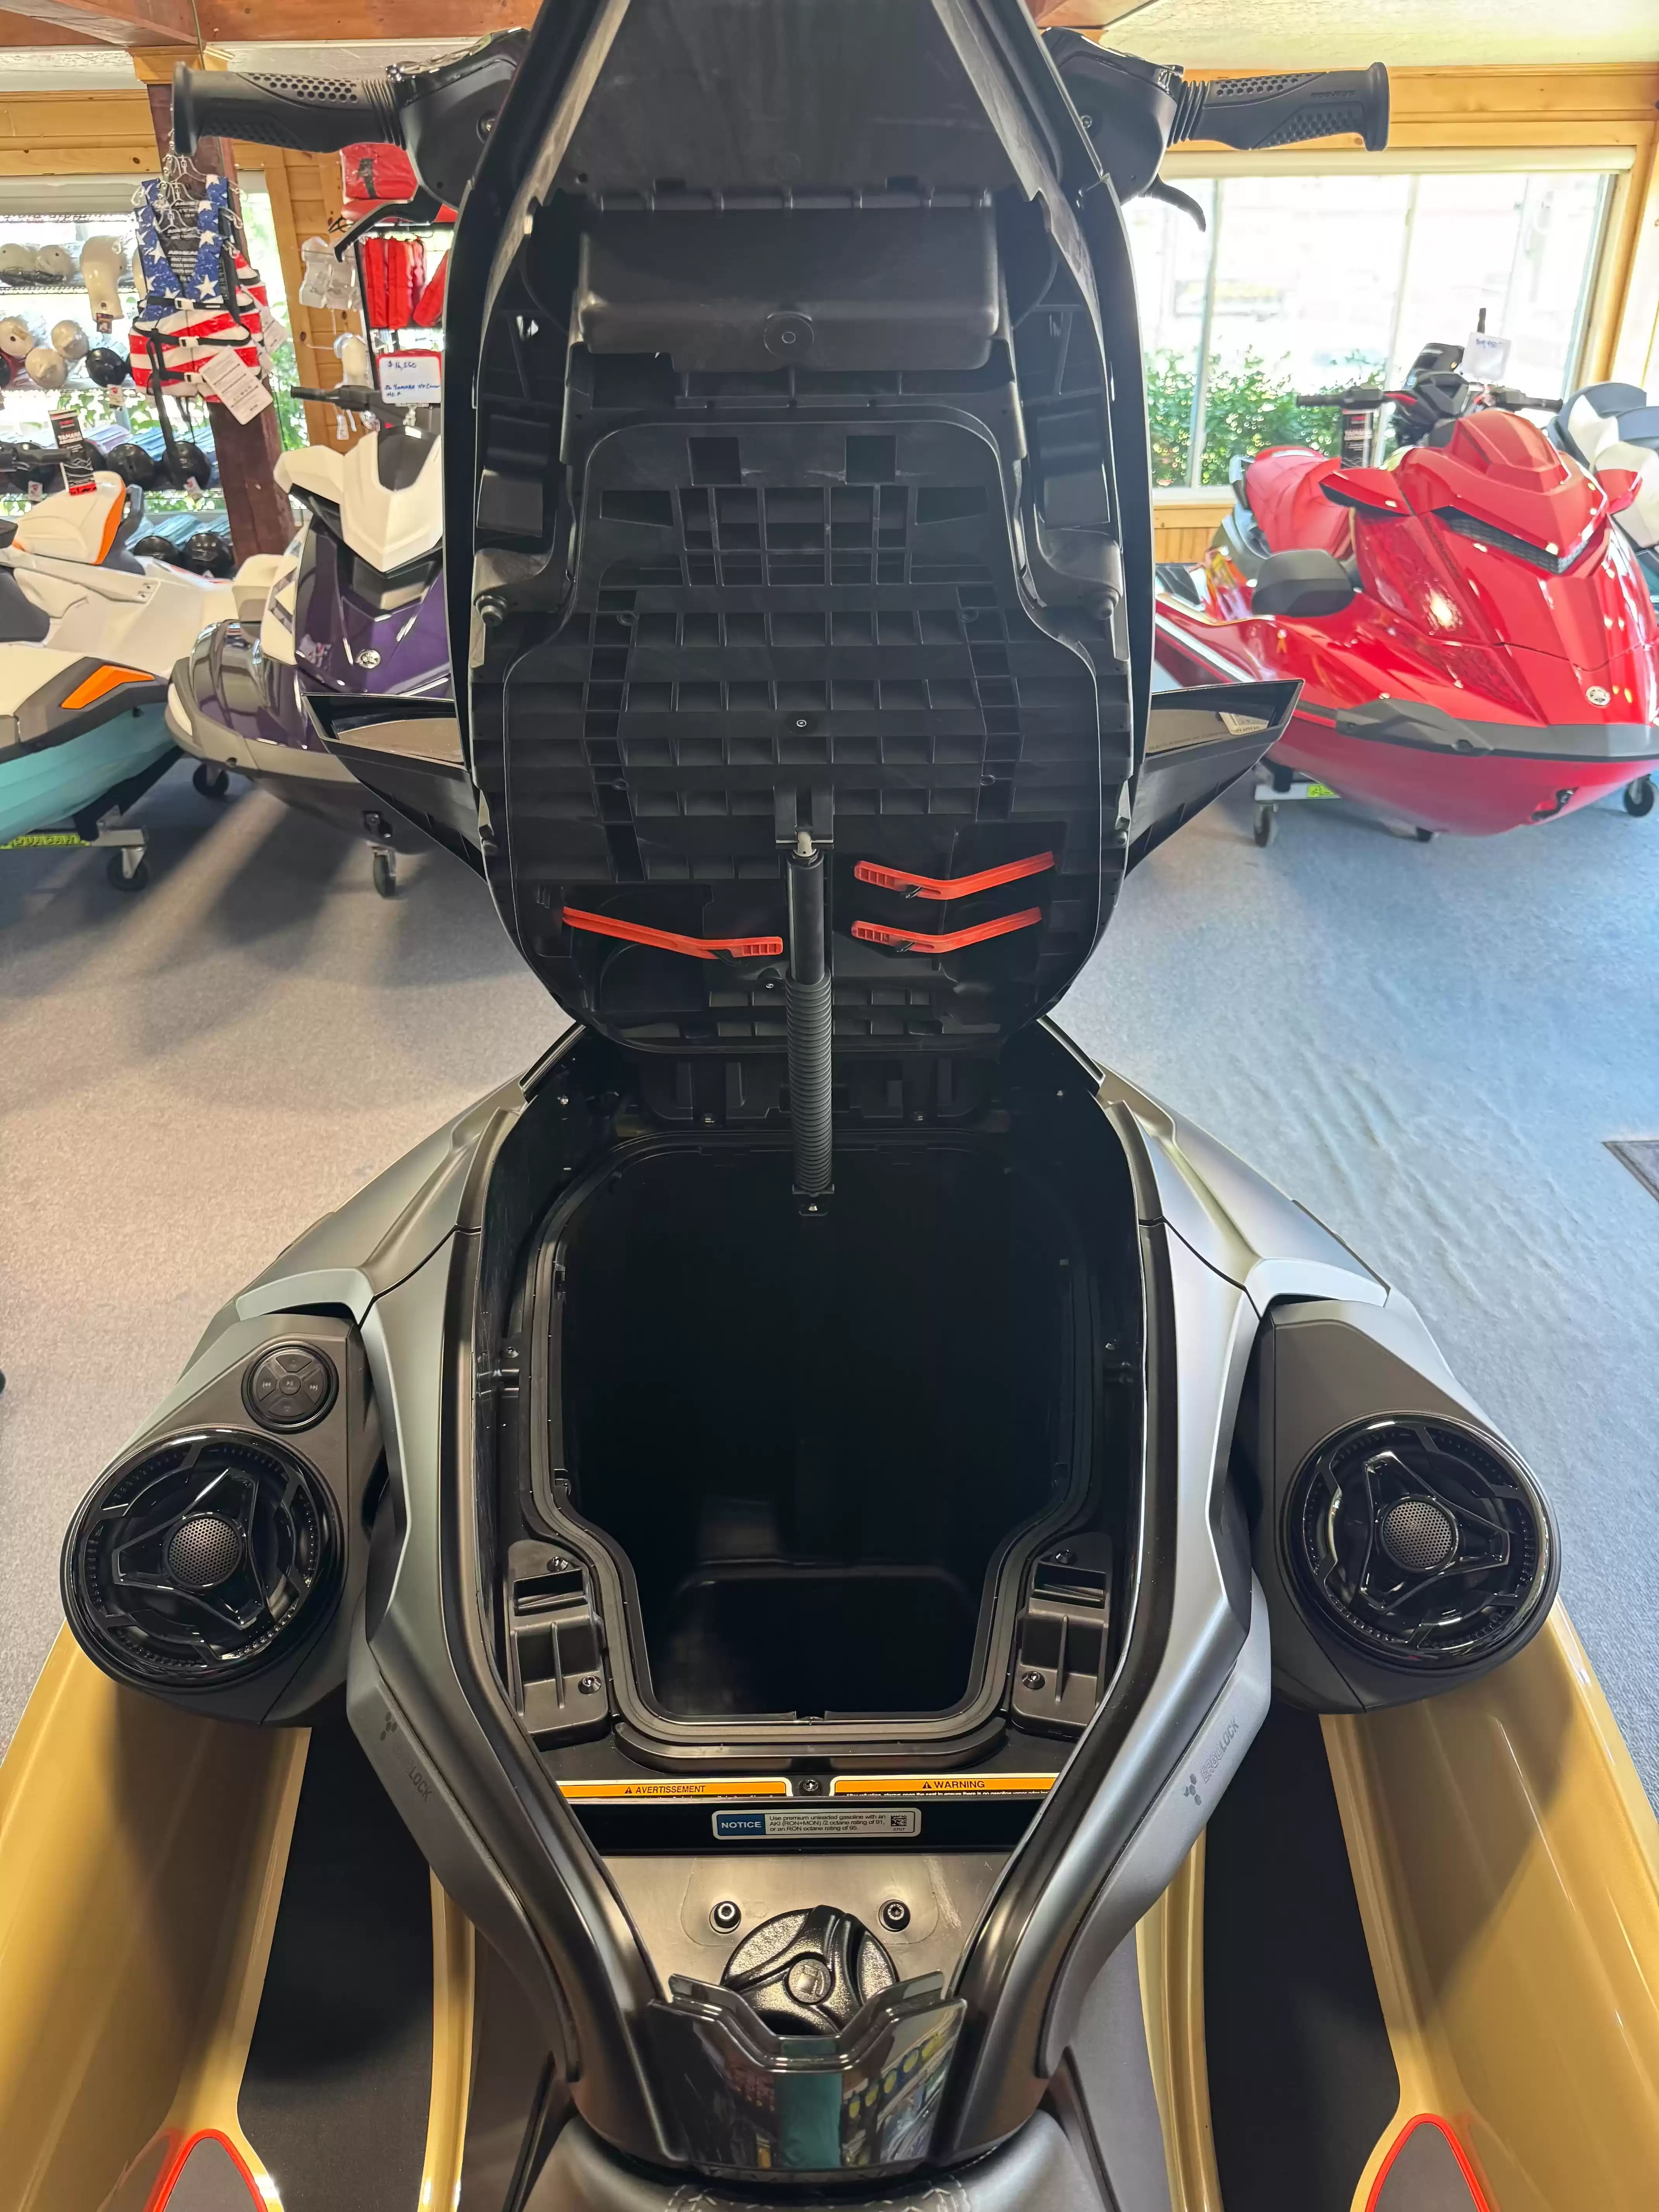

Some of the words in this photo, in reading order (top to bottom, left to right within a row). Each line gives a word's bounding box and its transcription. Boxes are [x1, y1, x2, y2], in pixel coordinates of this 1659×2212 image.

[934, 1780, 985, 1789] WARNING
[635, 1785, 706, 1794] AVERTISSEMENT
[721, 1821, 762, 1829] NOTICE
